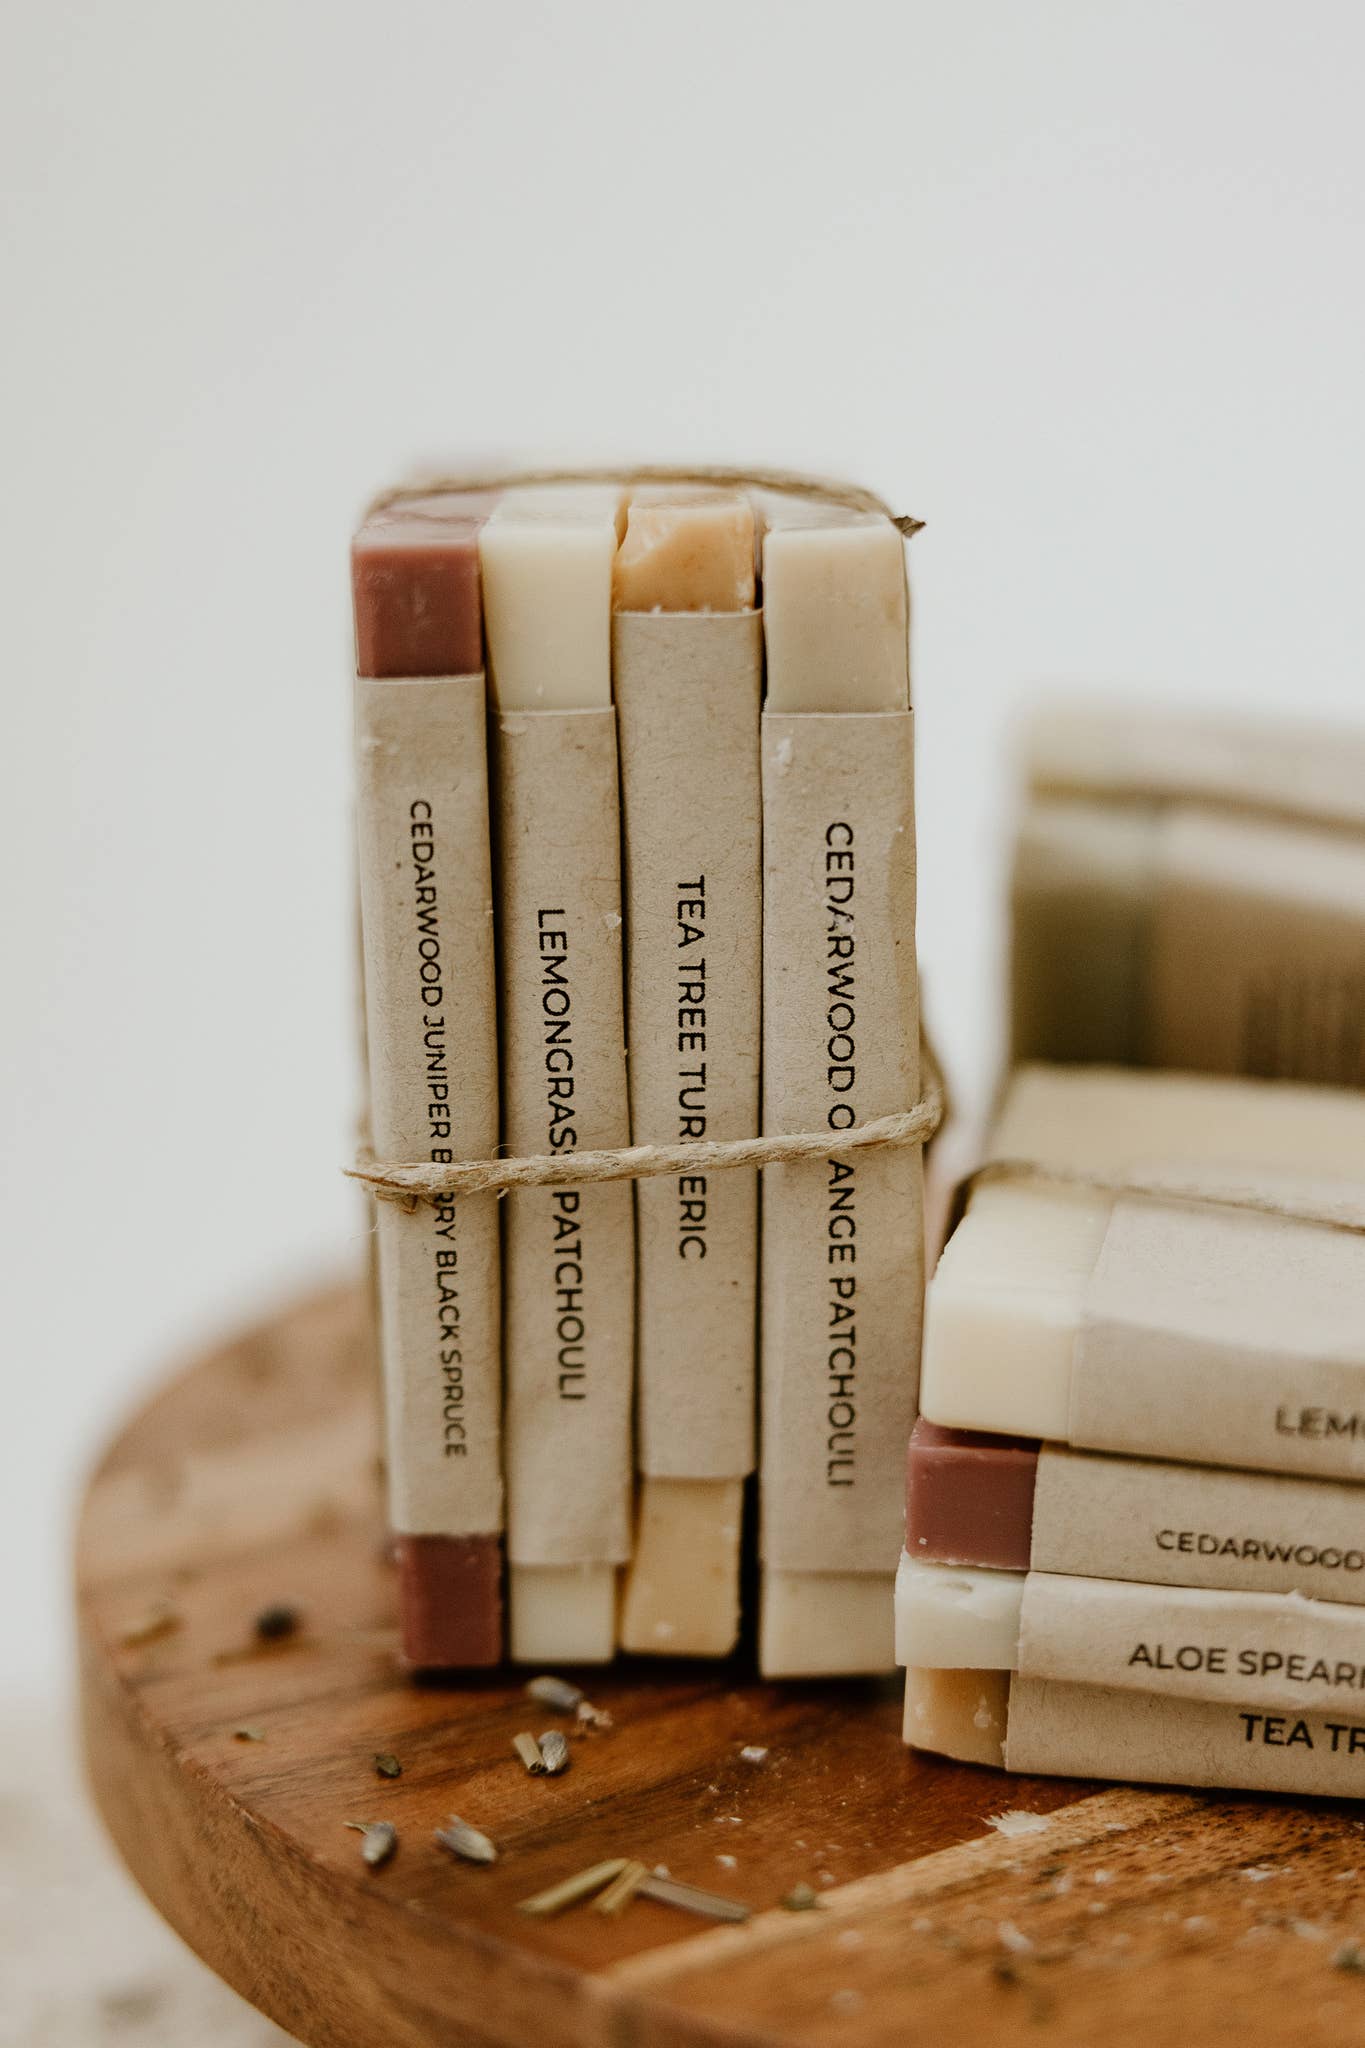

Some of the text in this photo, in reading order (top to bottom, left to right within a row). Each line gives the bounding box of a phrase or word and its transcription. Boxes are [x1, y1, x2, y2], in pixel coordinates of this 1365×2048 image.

[410, 800, 467, 1457] CEDARWOOD JUNIPER BRRY BLACK SPRUCE
[538, 909, 586, 1401] LEMONGRAS PATCHOULI
[677, 875, 707, 1260] TEA TREE TURERIC
[825, 822, 856, 1488] CEDARWOOD OANGE PATCHOULI
[1275, 1406, 1365, 1442] LEM
[1155, 1529, 1365, 1572] CEDARWOOD
[1128, 1643, 1365, 1689] ALOE SPEAR
[1240, 1713, 1314, 1749] TEA
